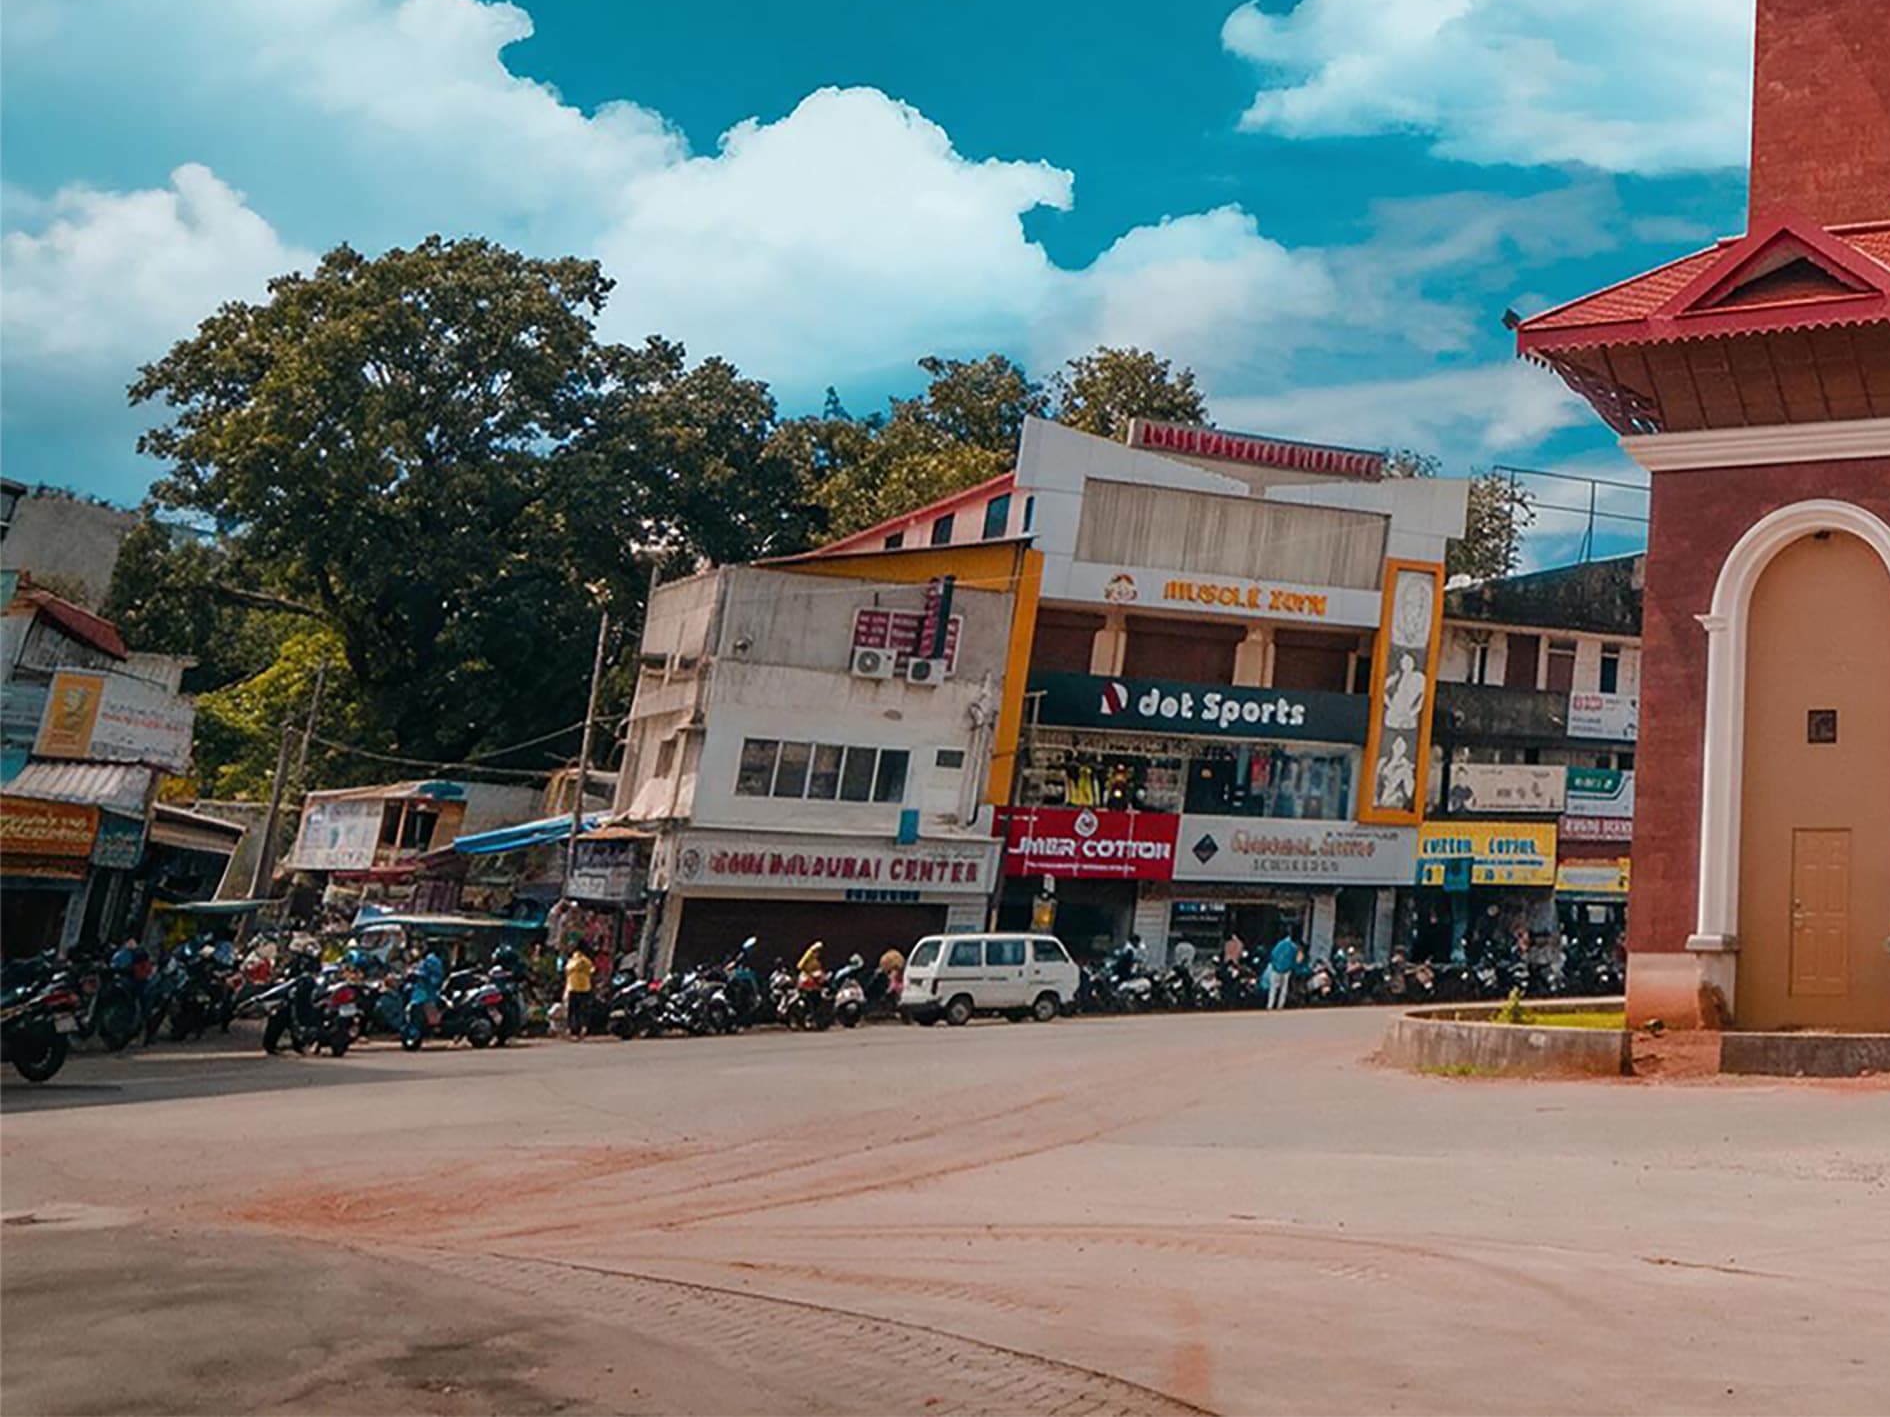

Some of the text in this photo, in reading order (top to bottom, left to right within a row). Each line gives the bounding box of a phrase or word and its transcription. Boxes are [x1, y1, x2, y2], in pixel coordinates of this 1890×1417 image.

[1138, 687, 1306, 729] dot Sports
[1082, 839, 1172, 860] COTTON
[889, 858, 979, 883] CENTER
